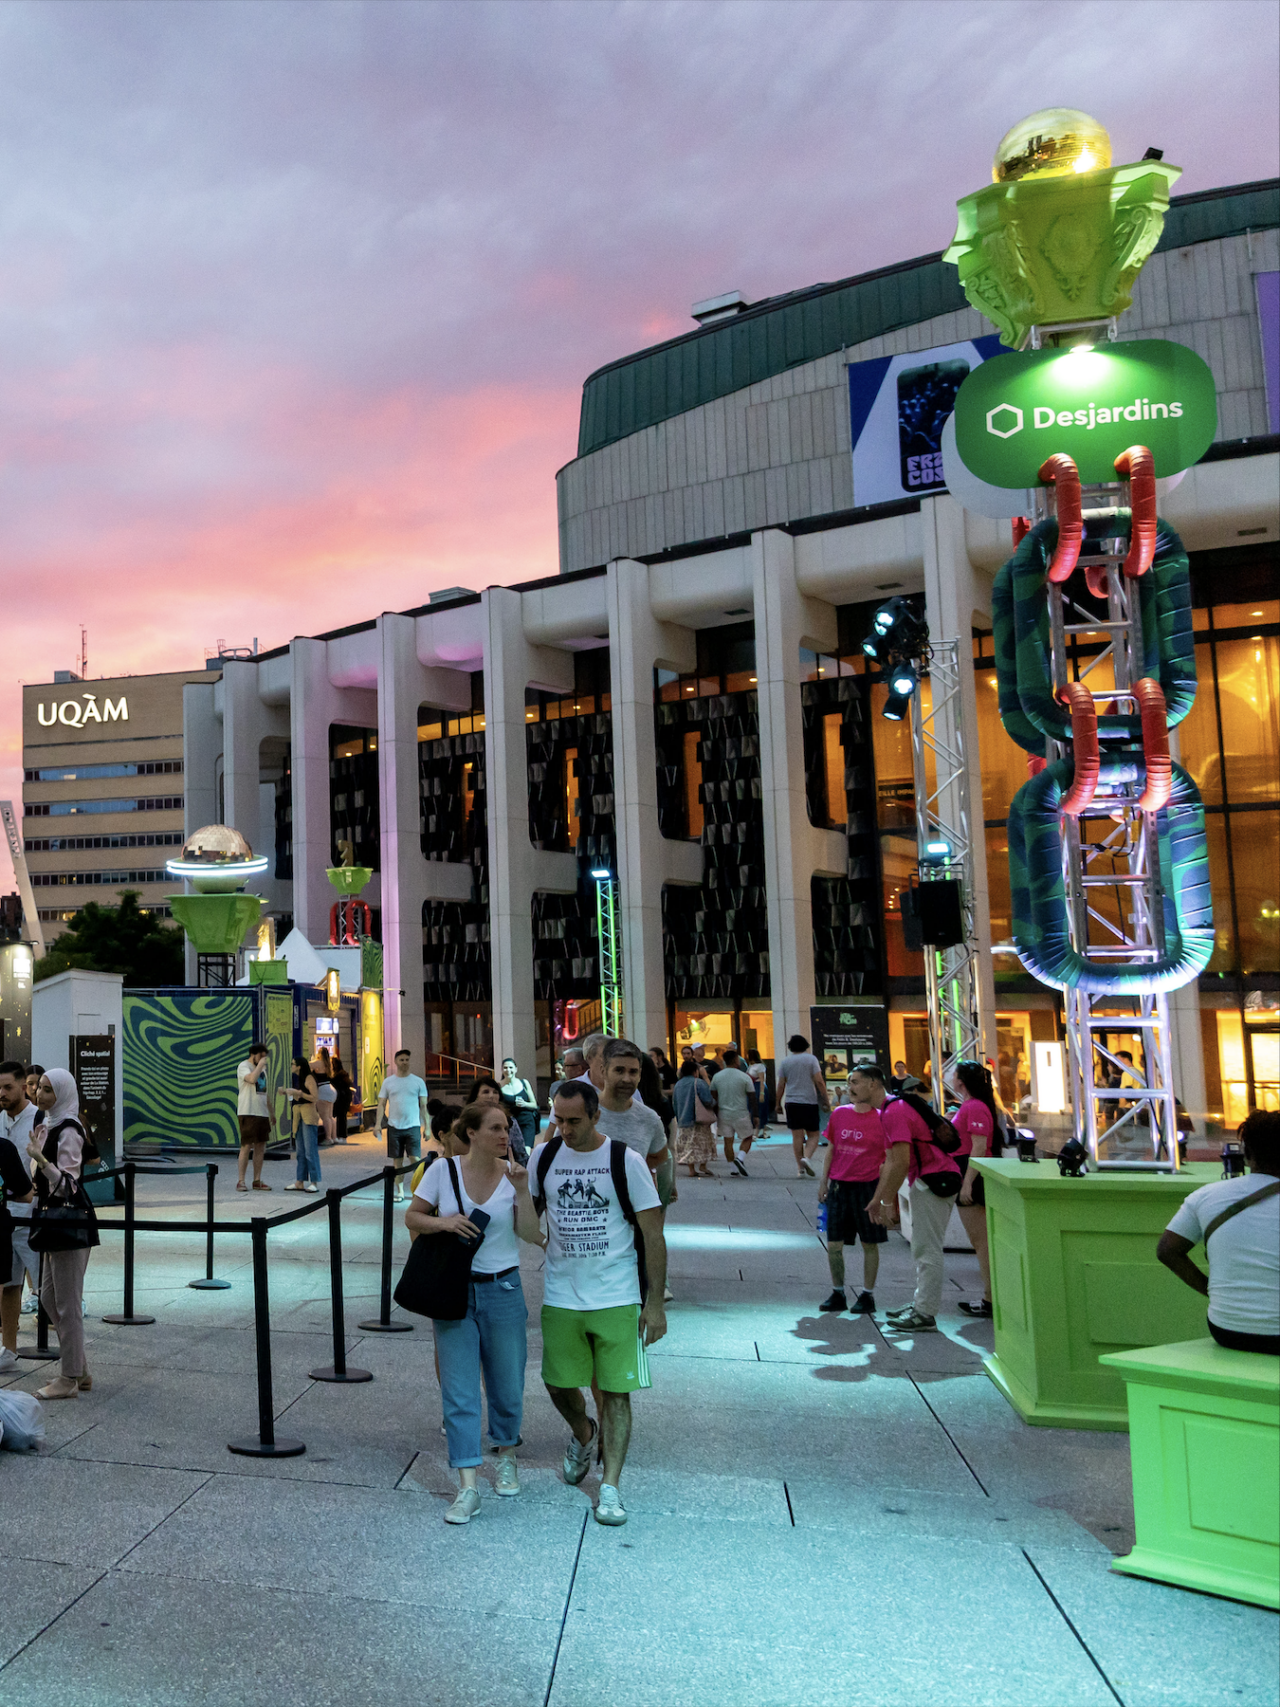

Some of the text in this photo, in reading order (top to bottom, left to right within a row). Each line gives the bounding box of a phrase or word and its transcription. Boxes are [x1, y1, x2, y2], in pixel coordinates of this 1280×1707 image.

[1033, 398, 1183, 430] Desjardins
[38, 693, 128, 728] UQÀM
[841, 1129, 863, 1141] grip
[578, 1241, 609, 1251] STADIUM
